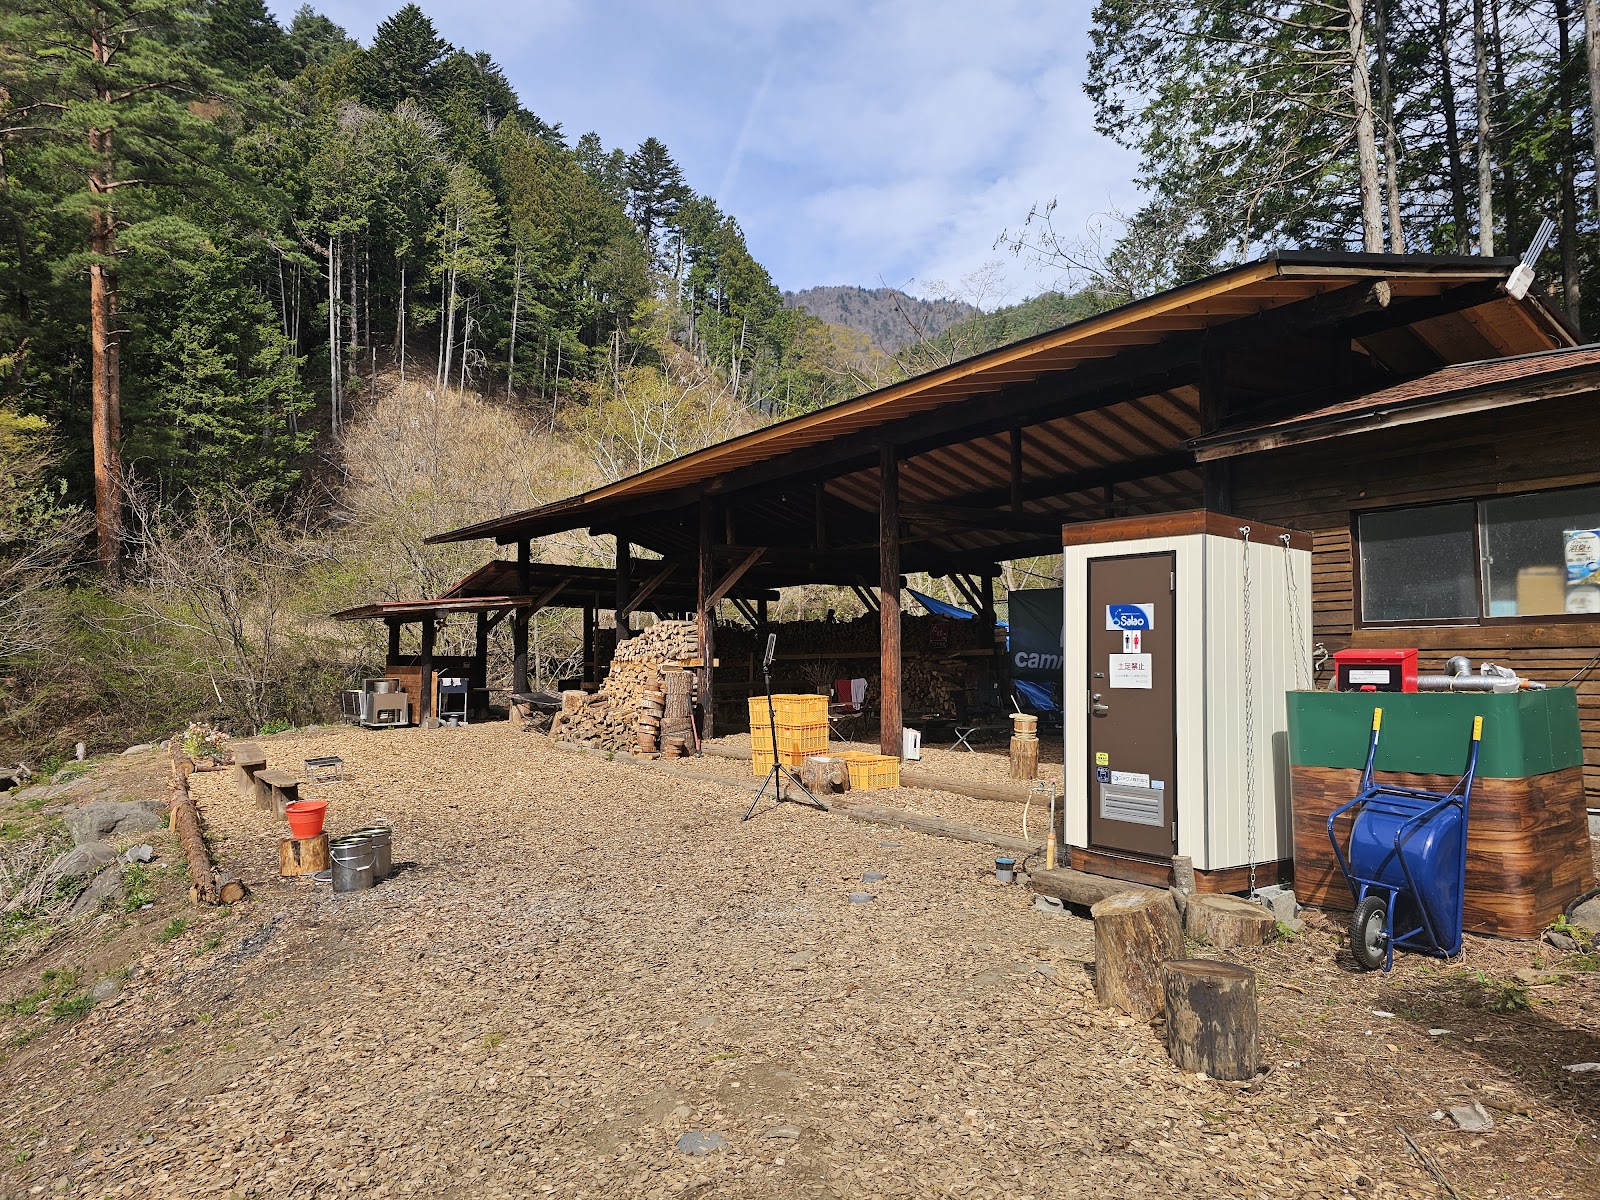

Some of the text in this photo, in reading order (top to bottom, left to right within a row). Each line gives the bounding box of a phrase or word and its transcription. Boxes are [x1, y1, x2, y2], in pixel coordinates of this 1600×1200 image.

[1120, 615, 1145, 627] Salao
[1117, 662, 1145, 671] 土足禁止
